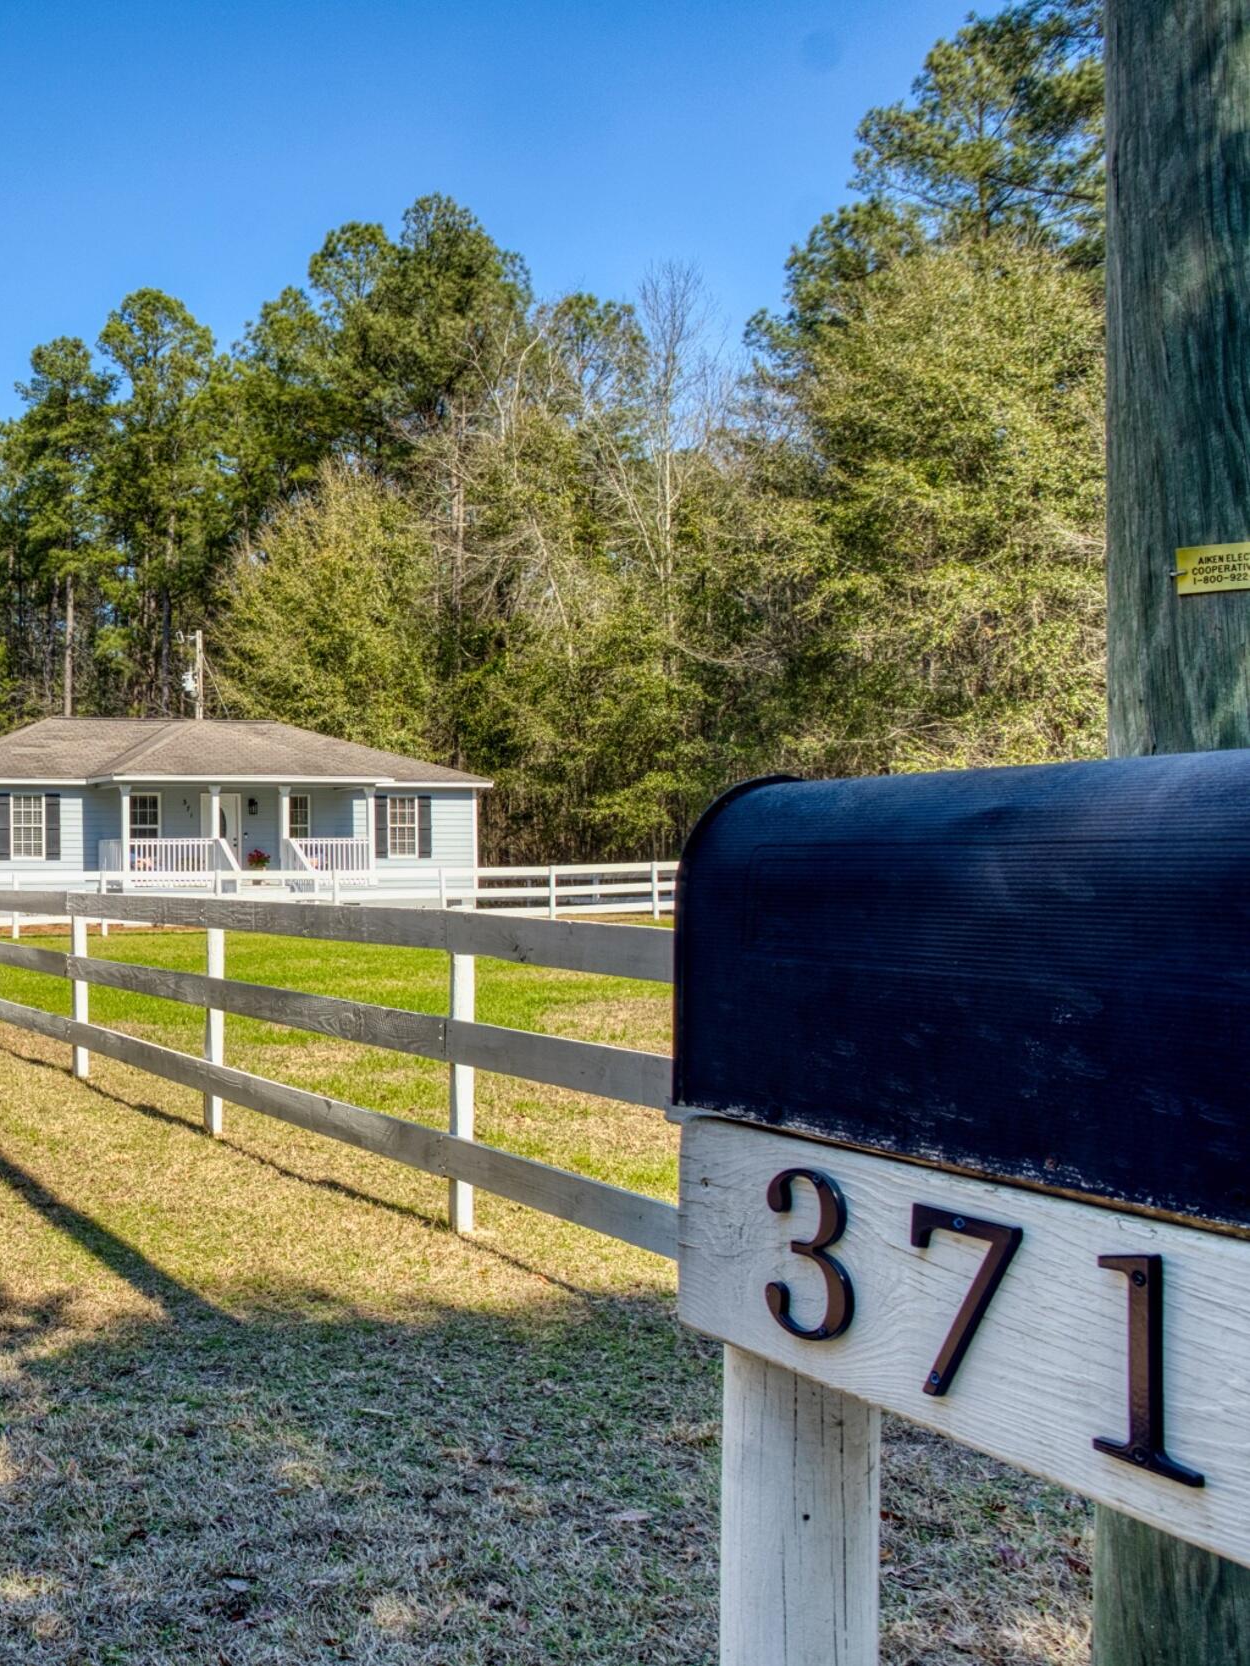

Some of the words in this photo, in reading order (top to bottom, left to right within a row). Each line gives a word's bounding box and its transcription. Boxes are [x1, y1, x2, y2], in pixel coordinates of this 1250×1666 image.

[1198, 555, 1224, 565] AIKEN
[1226, 553, 1250, 562] ELEC
[765, 1168, 1205, 1488] 371
